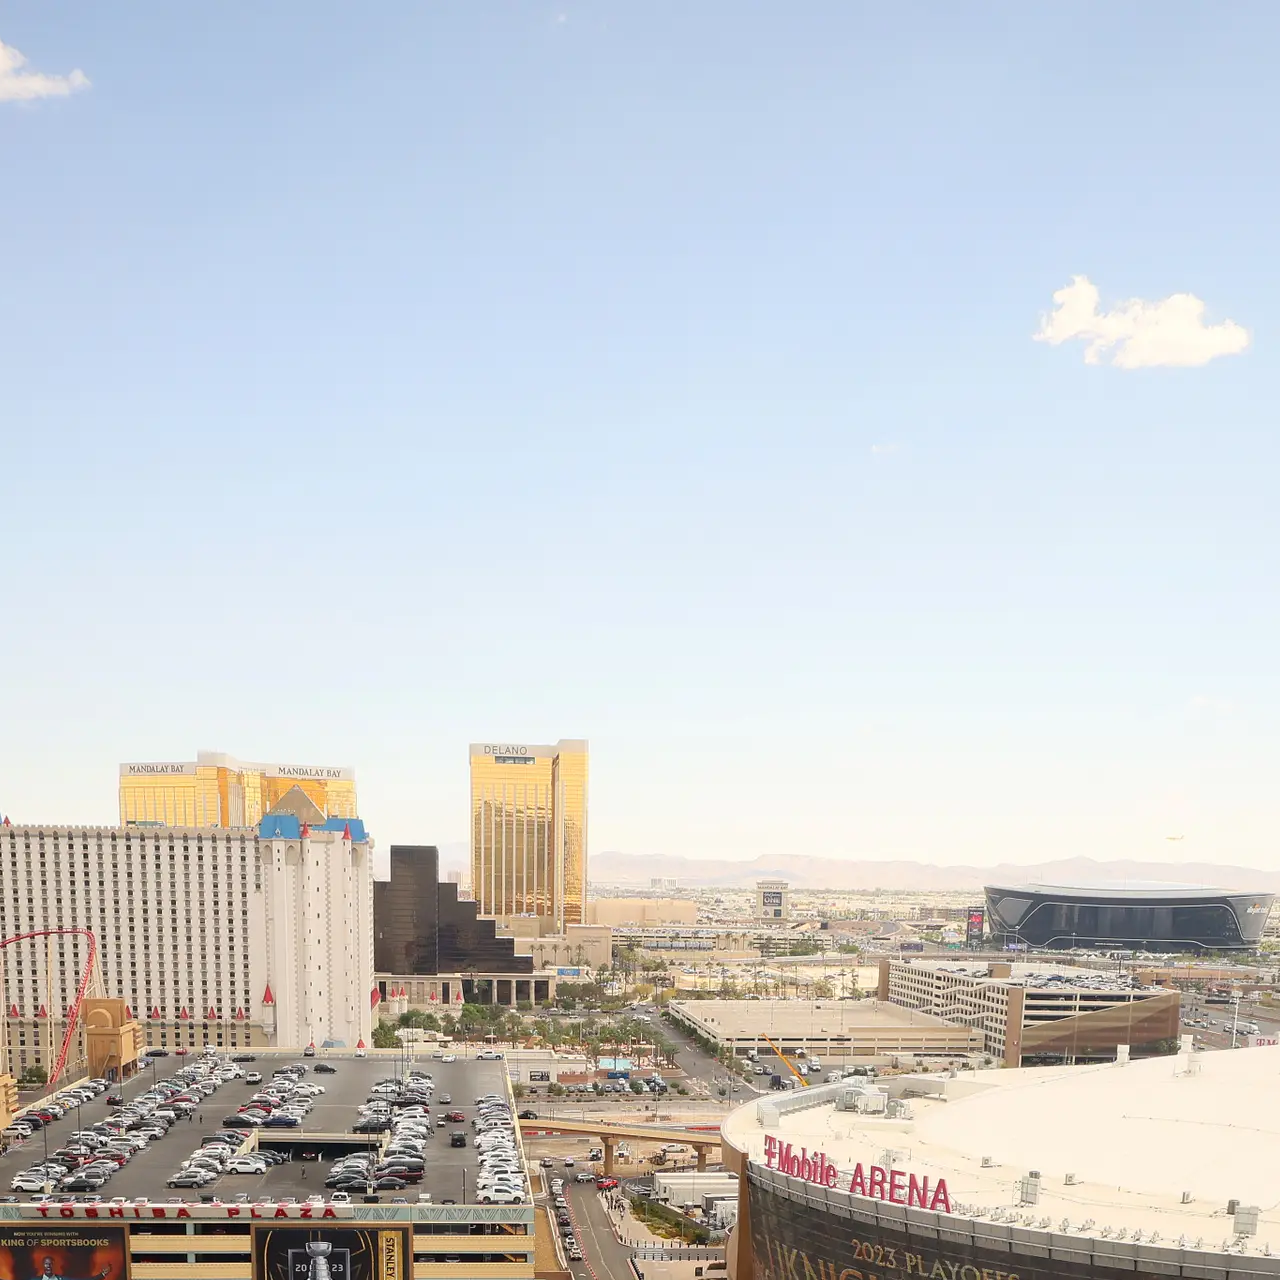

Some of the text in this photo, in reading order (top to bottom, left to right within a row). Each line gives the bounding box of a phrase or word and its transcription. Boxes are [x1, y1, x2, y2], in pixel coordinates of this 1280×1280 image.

[484, 745, 528, 755] DELANO
[129, 765, 185, 773] MANDALAY BAY
[278, 767, 341, 778] MANDALAY BAY
[849, 1162, 951, 1213] ARENA
[36, 1207, 337, 1219] TOSHIBA PLAZA
[1, 1239, 24, 1247] KING
[26, 1239, 39, 1247] OF
[40, 1239, 109, 1247] SPORTSBOOKS
[385, 1237, 395, 1279] STANLEY
[851, 1238, 899, 1269] 2023
[295, 1264, 344, 1272] 20 23
